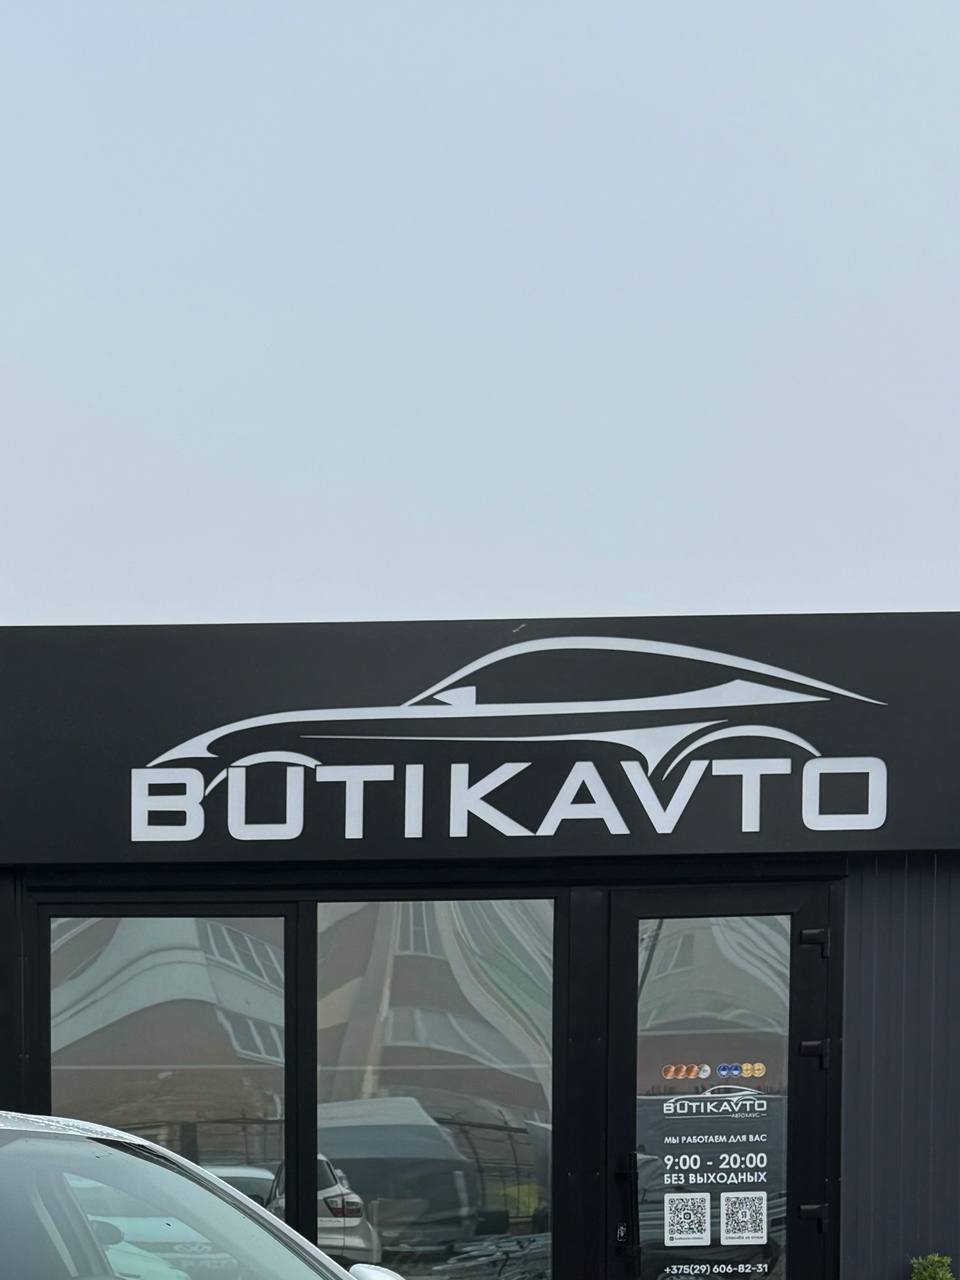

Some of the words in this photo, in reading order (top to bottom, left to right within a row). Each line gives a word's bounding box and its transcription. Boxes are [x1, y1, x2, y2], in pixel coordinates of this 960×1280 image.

[131, 755, 888, 842] BUTIKAVTO
[663, 1100, 767, 1114] BUTIKAVTO
[664, 1136, 680, 1144] МЫ
[681, 1135, 727, 1144] РАБОТАЕМ
[728, 1134, 747, 1143] ДЛЯ
[748, 1134, 767, 1142] ВАС
[663, 1154, 701, 1170] 9:00
[719, 1153, 767, 1169] 20:00
[663, 1173, 685, 1185] БЕЗ
[688, 1171, 767, 1185] ВЫХОДНЫХ
[664, 1263, 711, 1276] +375(29)
[712, 1263, 768, 1274] 606-82-31
